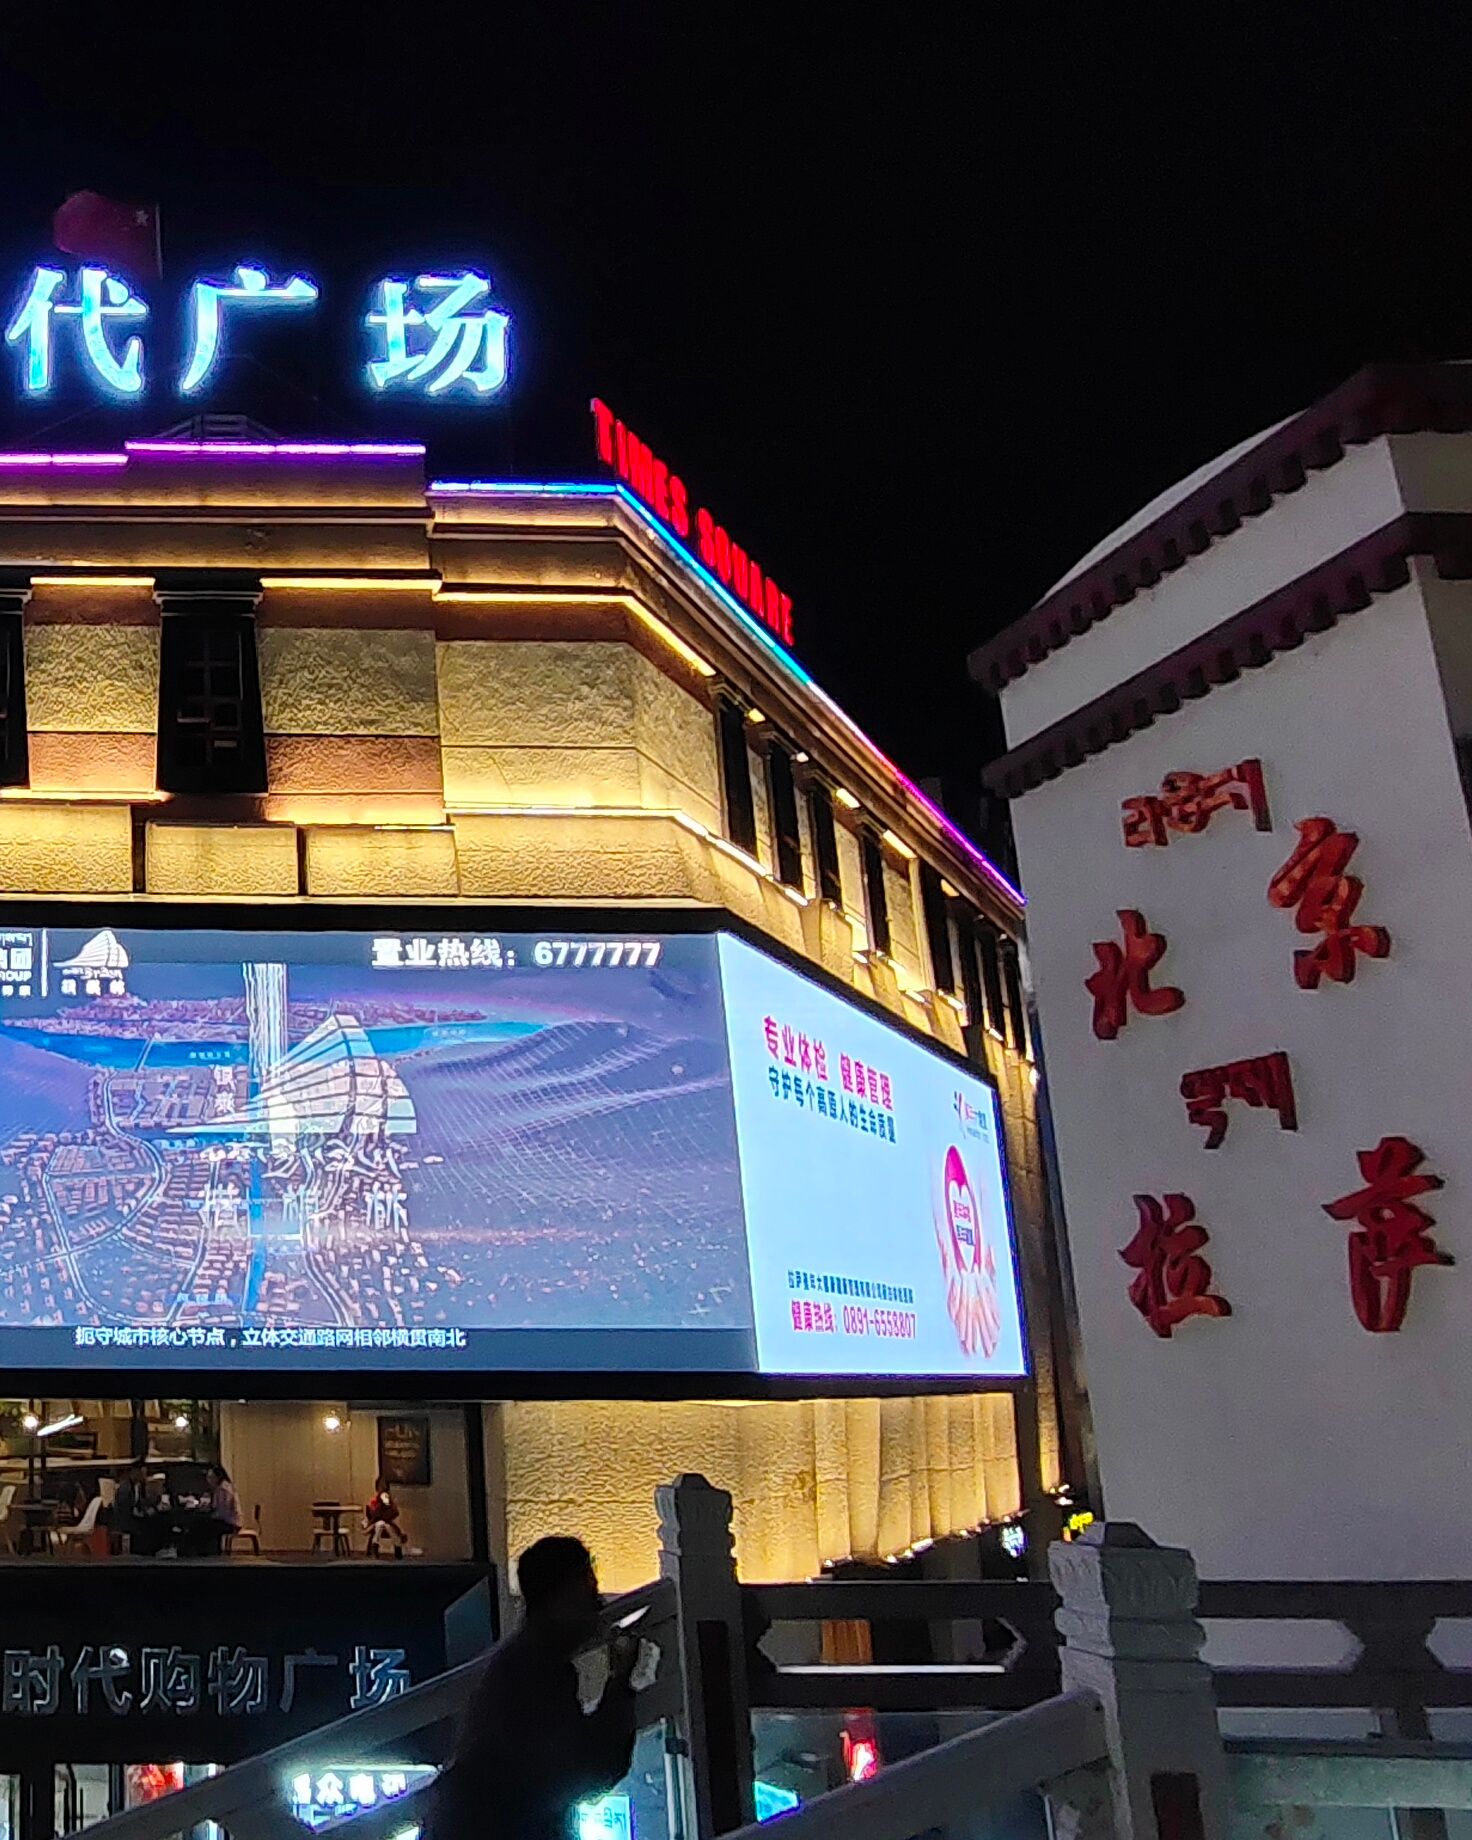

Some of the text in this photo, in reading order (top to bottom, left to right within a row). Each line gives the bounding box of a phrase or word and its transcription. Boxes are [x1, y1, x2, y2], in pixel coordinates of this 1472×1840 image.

[533, 941, 662, 968] 6777777
[764, 1016, 828, 1081] 专业体检
[1118, 1136, 1455, 1339] 拉萨
